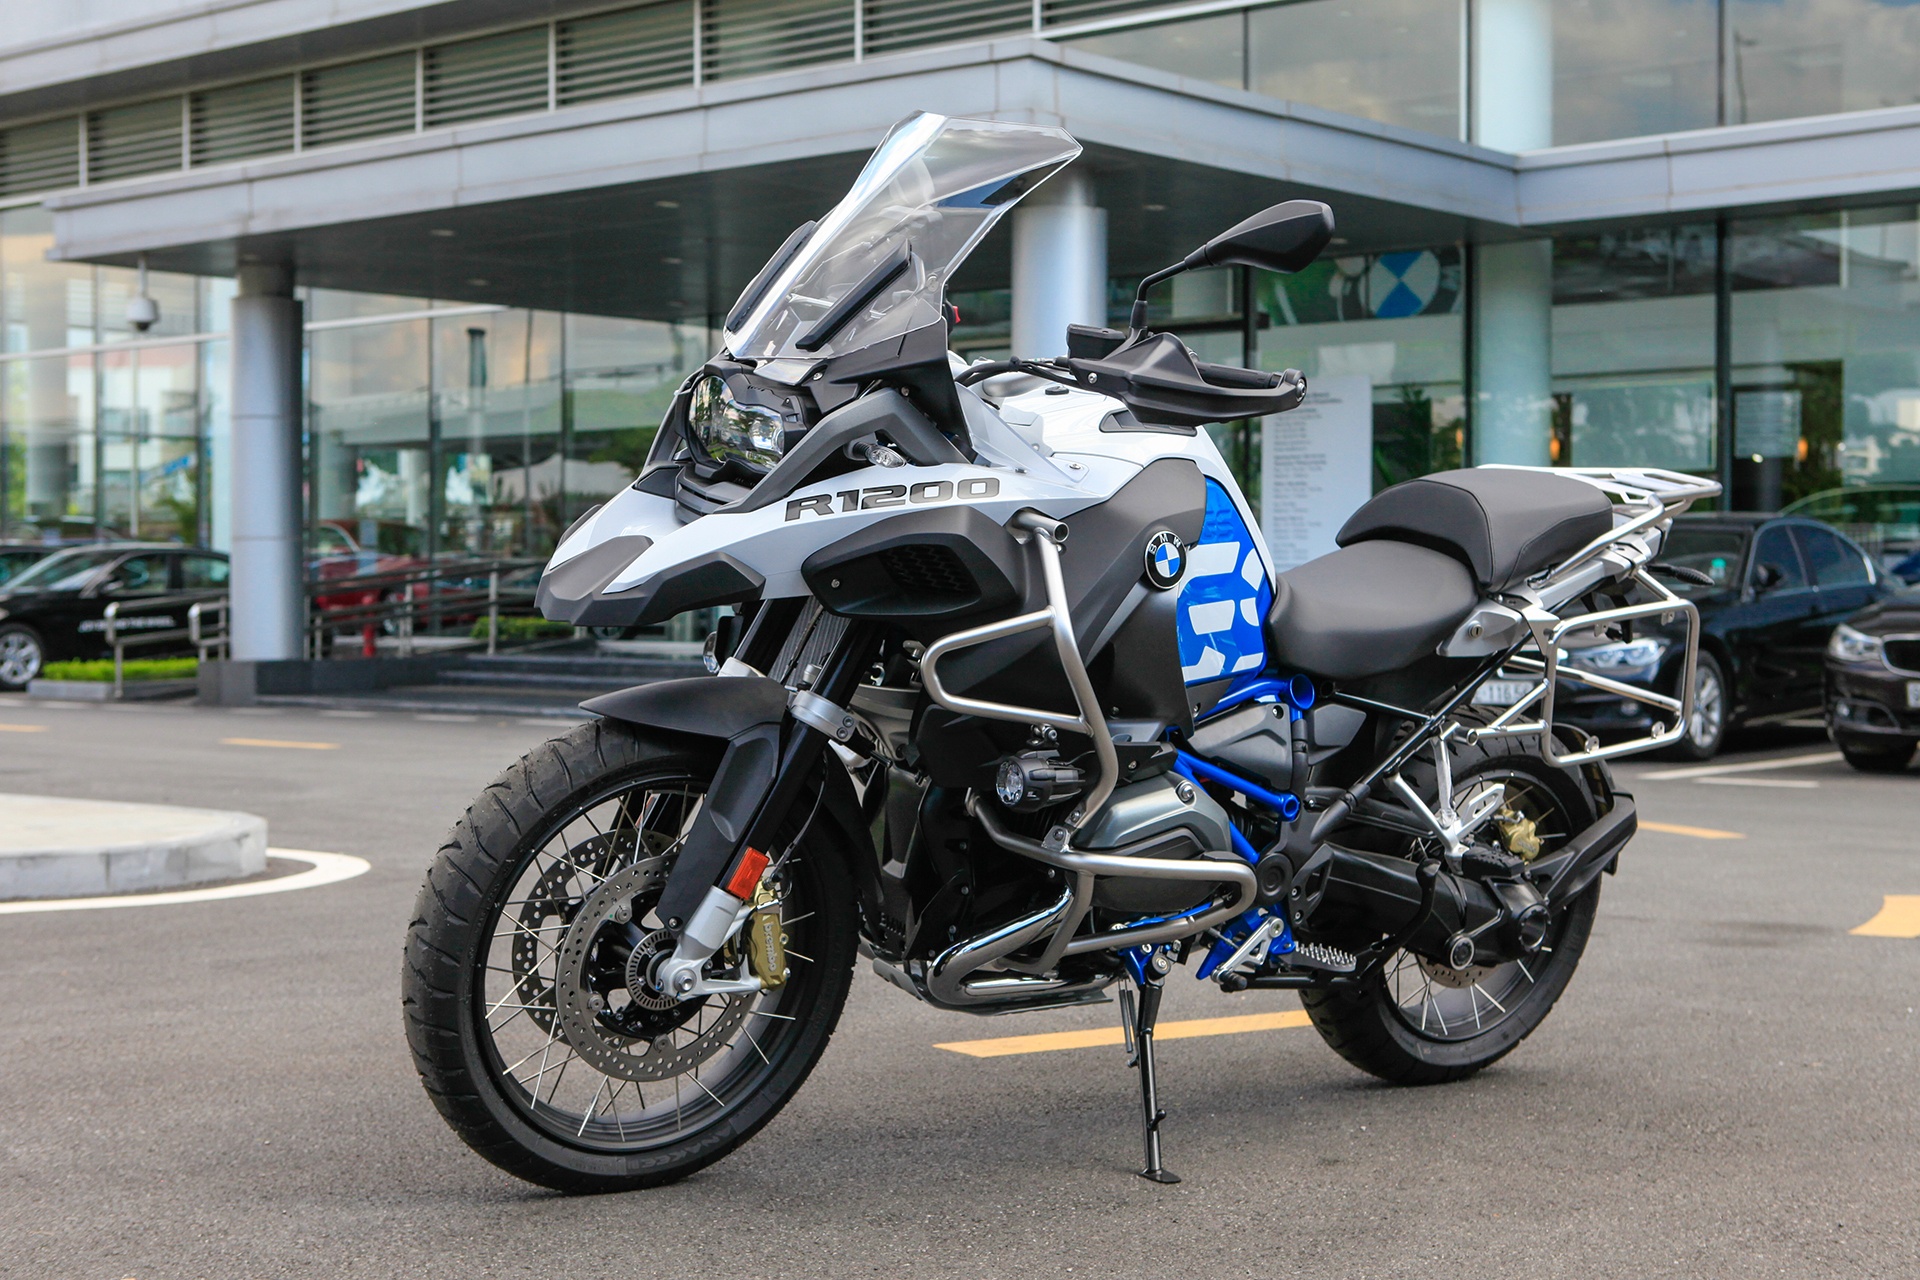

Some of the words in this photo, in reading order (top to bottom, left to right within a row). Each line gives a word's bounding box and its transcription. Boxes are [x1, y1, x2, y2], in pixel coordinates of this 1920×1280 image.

[785, 477, 1000, 522] R1200
[1148, 532, 1182, 556] BMW
[763, 921, 778, 972] brembo
[641, 1124, 733, 1169] ANAKEE
